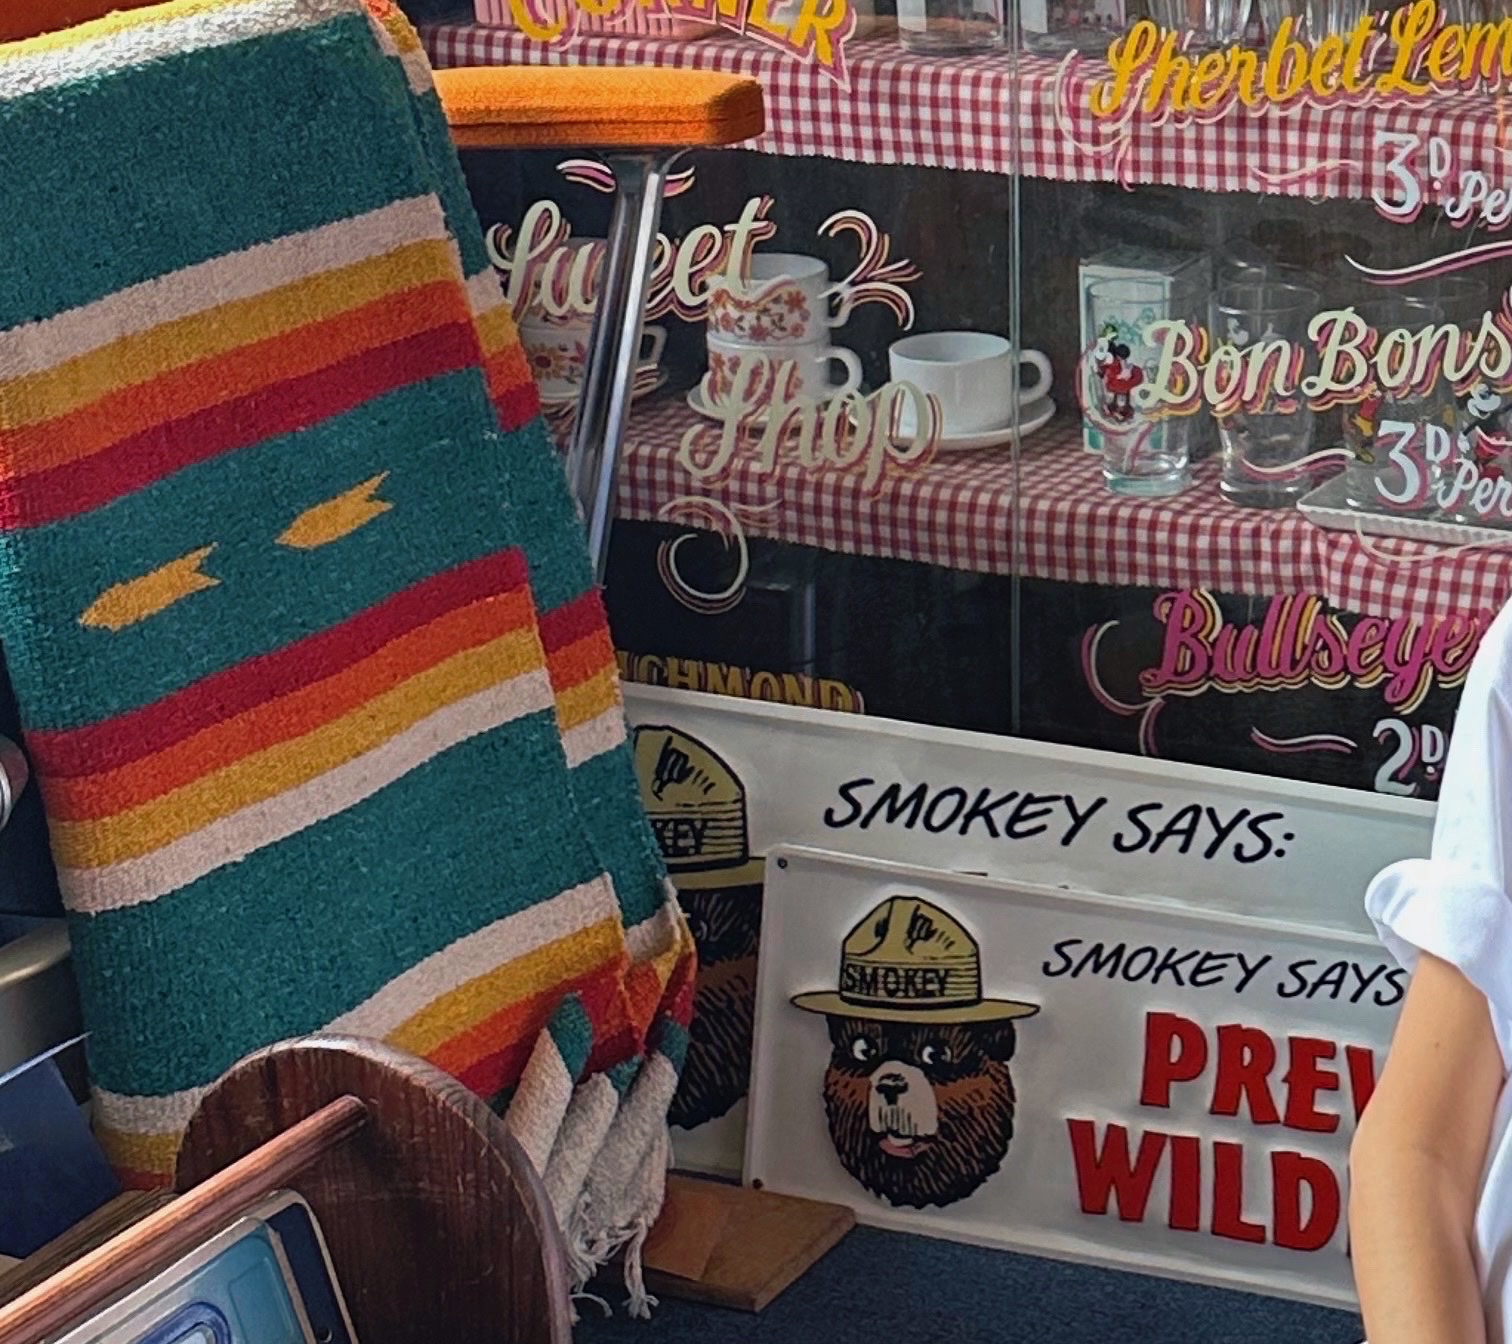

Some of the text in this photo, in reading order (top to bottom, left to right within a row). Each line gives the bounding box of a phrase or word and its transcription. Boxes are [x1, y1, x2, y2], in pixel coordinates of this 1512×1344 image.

[1083, 11, 1386, 128] Sherbet
[1136, 318, 1302, 408] Bon
[681, 348, 938, 491] Shop
[1141, 589, 1488, 704] Bullseye
[824, 776, 1295, 864] SMOKEY SAYS:
[844, 965, 953, 998] SMOKEY
[1043, 938, 1405, 1008] SMOKEY SAYS
[1066, 1117, 1343, 1253] WILD
